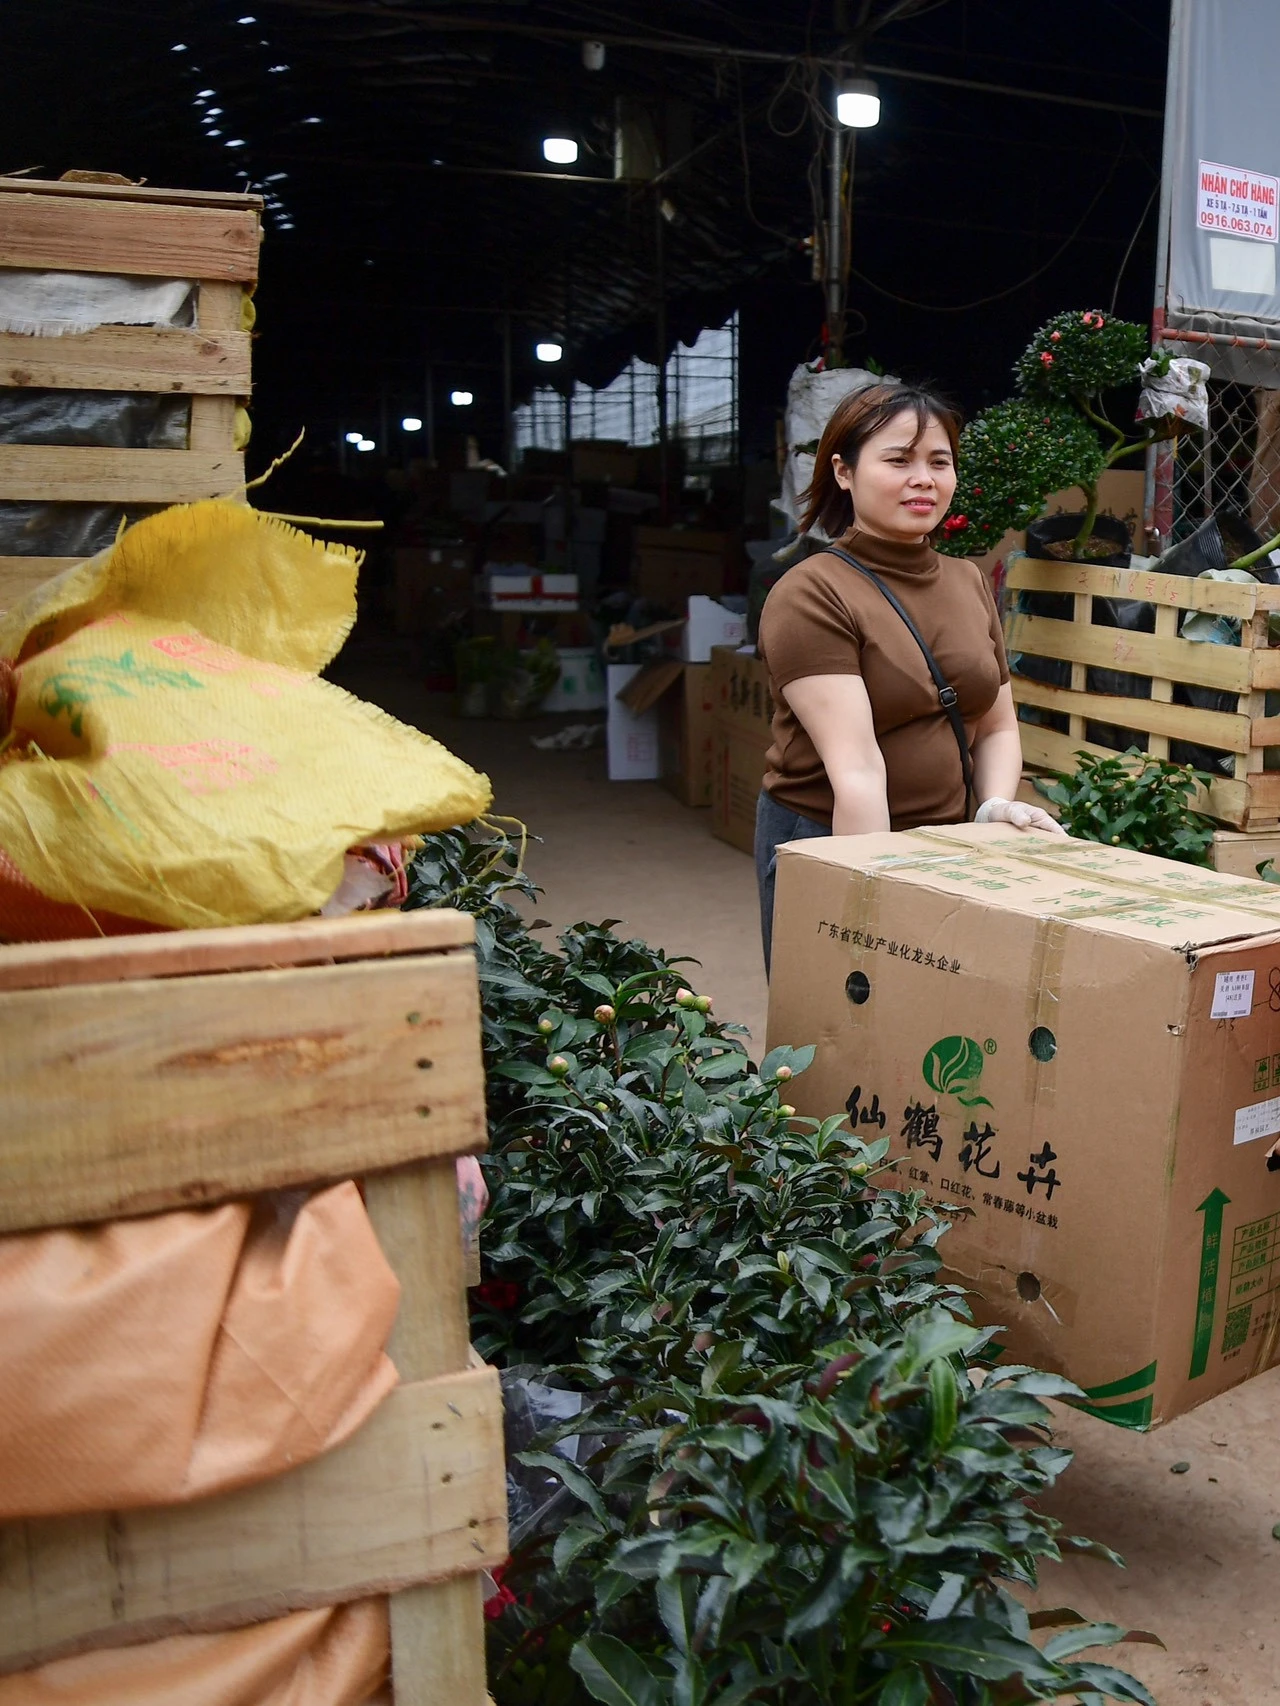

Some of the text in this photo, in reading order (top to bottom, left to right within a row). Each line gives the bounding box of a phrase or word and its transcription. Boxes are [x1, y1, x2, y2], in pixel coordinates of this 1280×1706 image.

[1201, 172, 1275, 206] NHẬN CHỞ HÀNG
[1200, 212, 1273, 237] 0916.063.074
[817, 920, 962, 975] 广东省农业产业化龙头企业
[846, 1085, 1062, 1201] 仙鹤花卉
